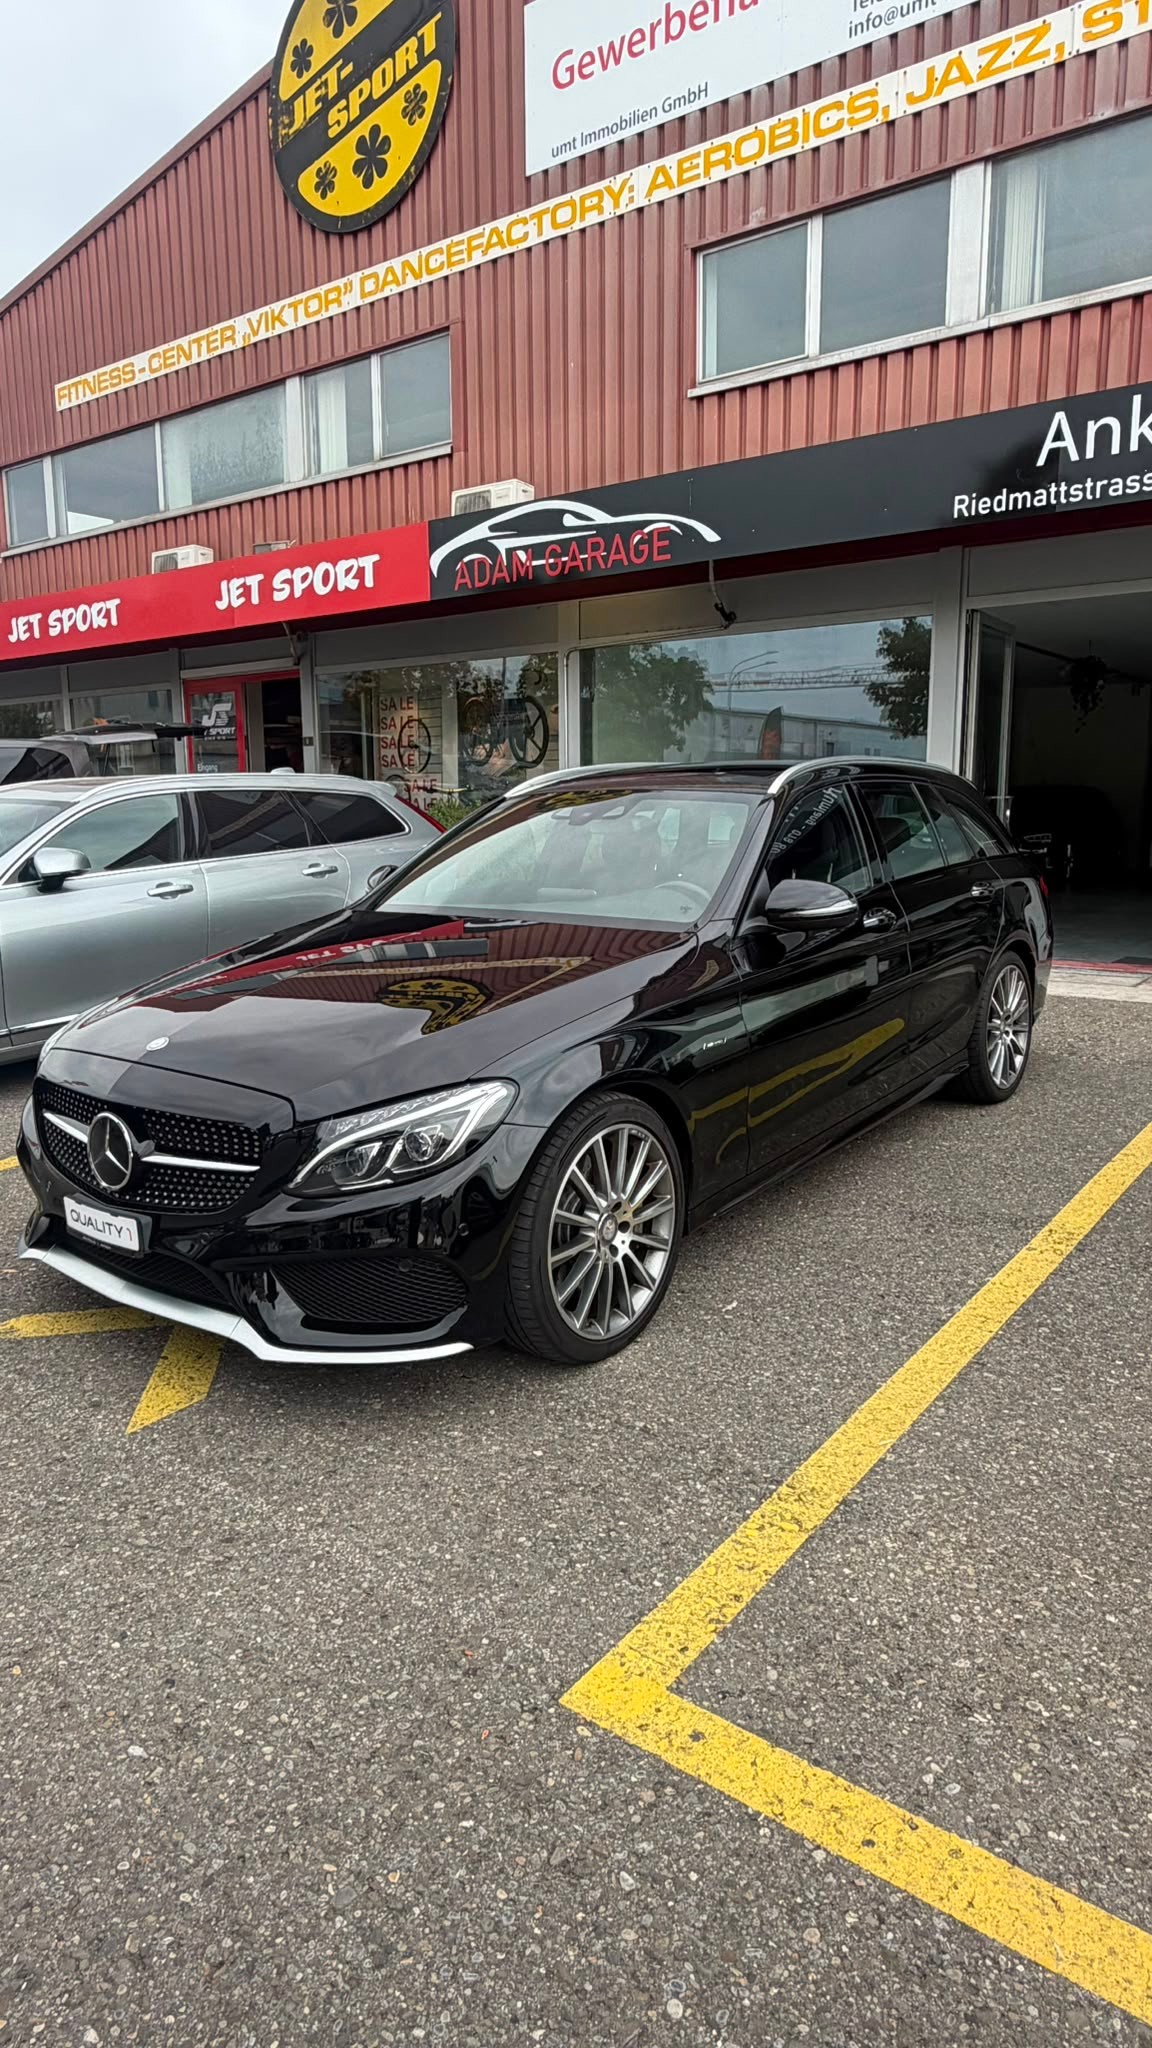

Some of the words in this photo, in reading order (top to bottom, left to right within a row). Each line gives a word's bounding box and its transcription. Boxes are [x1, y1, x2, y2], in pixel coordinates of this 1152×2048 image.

[288, 58, 354, 136] JET-
[327, 11, 442, 139] SPORT
[551, 136, 577, 158] umt
[580, 106, 658, 148] Immobilien
[661, 81, 708, 113] GmbH
[359, 172, 635, 300] DANCEFACTORY:
[645, 87, 890, 198] AEROBICS,
[906, 18, 1066, 106] JAZZ,
[1036, 394, 1152, 467] Ank
[953, 471, 1152, 518] Riedmattstrass
[215, 573, 264, 610] JET
[272, 554, 380, 602] SPORT
[454, 548, 533, 591] ADAM
[544, 526, 671, 577] GARAGE
[8, 613, 42, 643] JET
[49, 598, 121, 637] SPORT
[70, 1208, 123, 1239] QUALITY
[125, 1227, 133, 1242] 1
